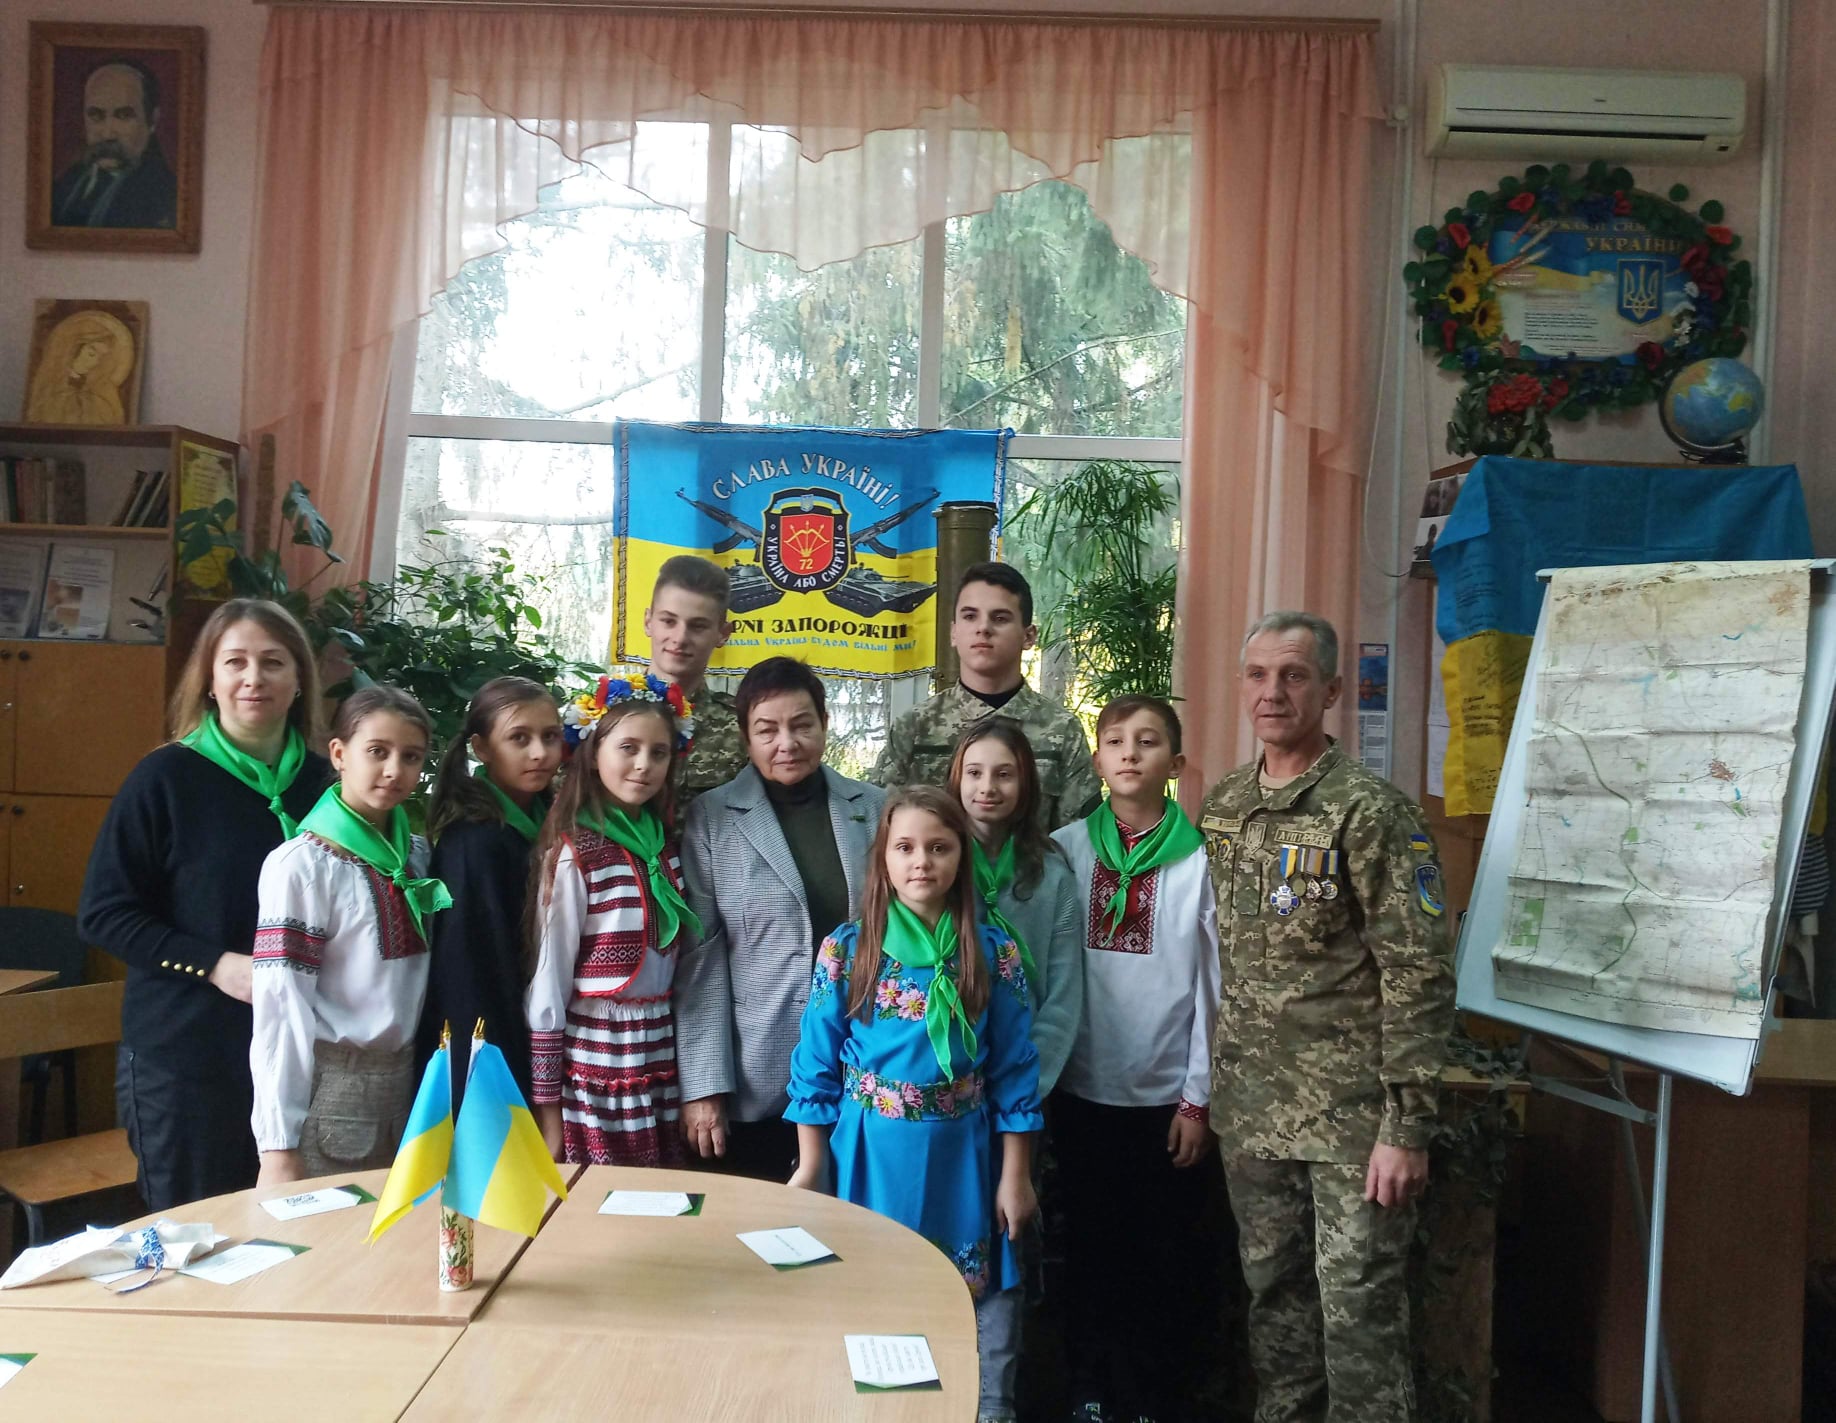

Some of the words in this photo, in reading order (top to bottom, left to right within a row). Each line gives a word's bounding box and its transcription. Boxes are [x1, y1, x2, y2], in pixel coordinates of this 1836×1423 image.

[712, 457, 791, 499] СЛАВА
[801, 453, 900, 510] УКРАЇНІ!
[767, 536, 790, 584] УКРАЇНА
[793, 576, 817, 588] АБО
[821, 536, 846, 583] СМЕРТЬ!
[799, 558, 813, 570] 72
[771, 616, 908, 640] ЗАПОРОЖЦІ
